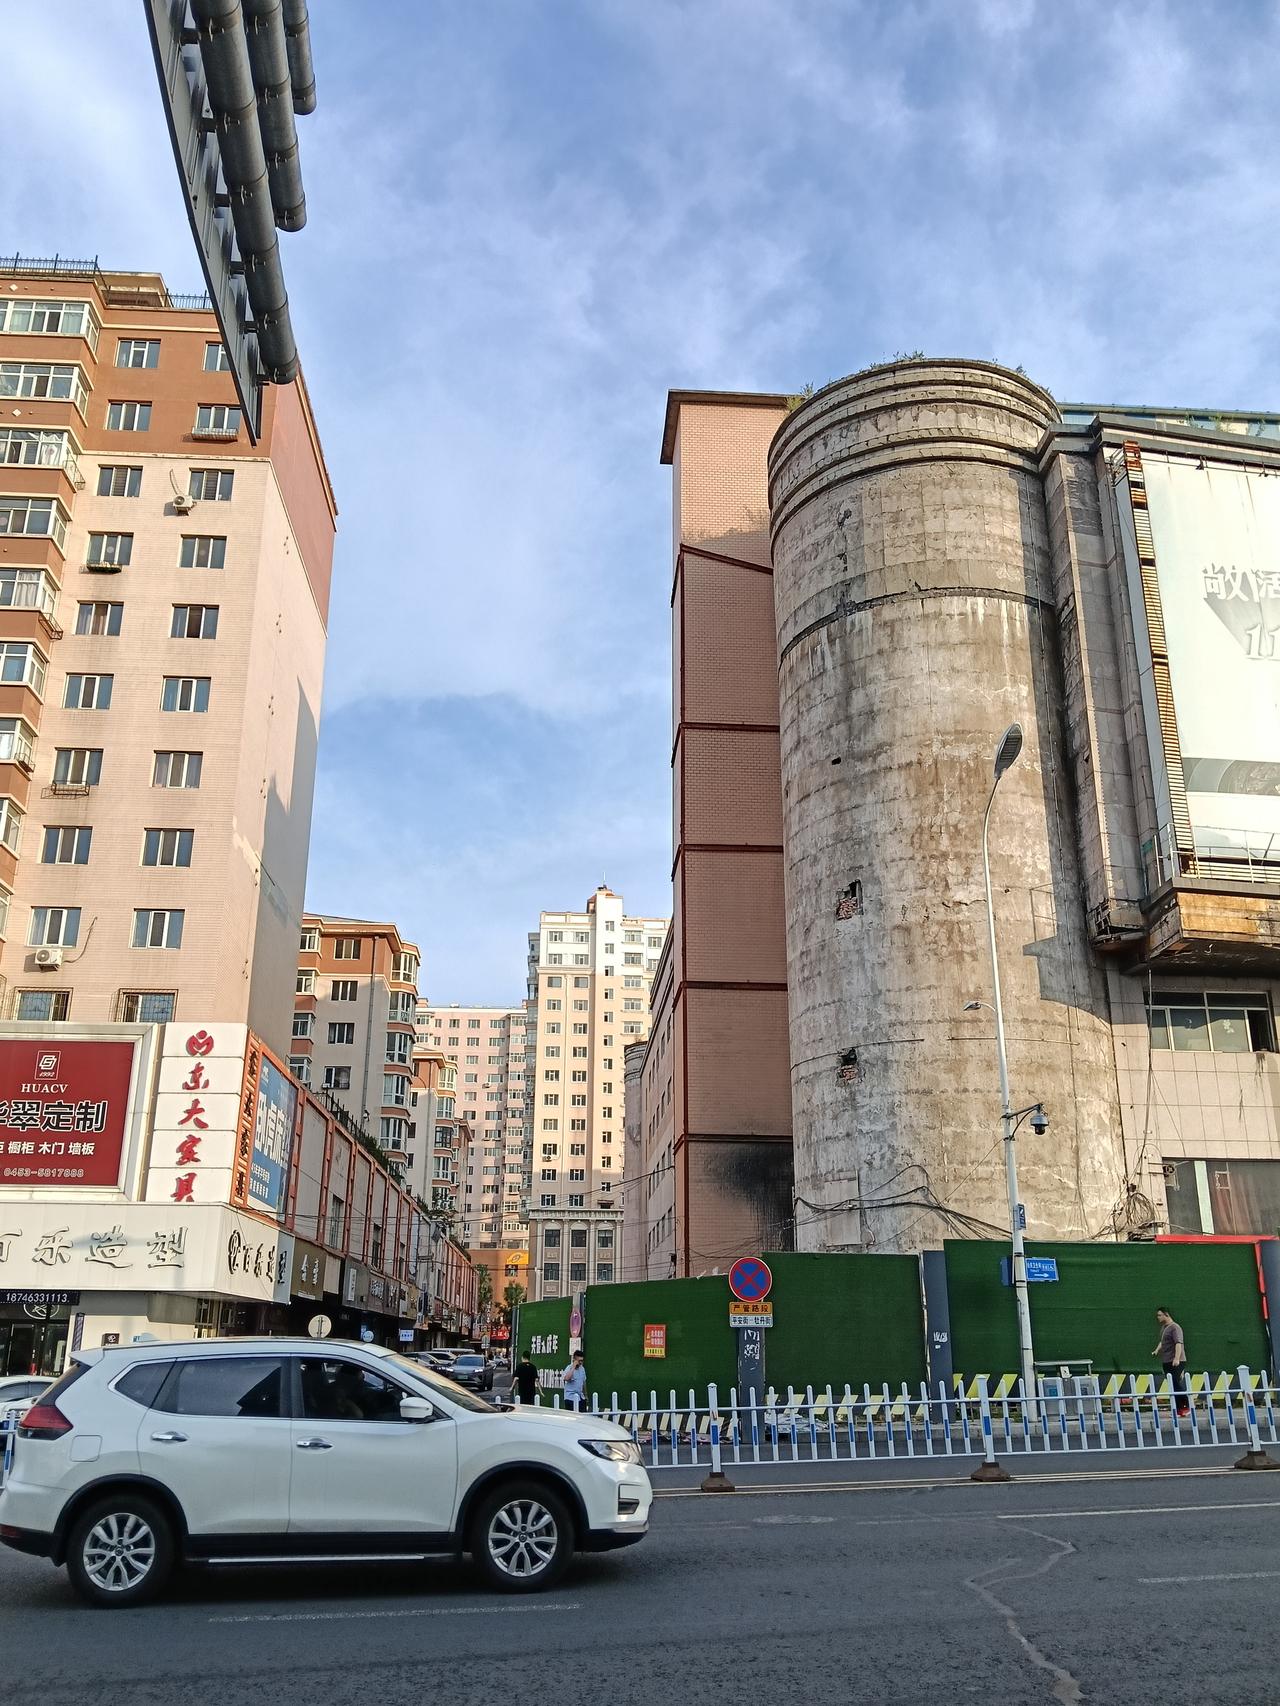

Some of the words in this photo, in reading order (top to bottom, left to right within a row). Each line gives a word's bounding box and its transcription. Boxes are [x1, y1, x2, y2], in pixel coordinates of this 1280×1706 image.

[21, 1083, 68, 1094] HUACV
[0, 1099, 109, 1133] 翠定制
[8, 1141, 35, 1155] 橱柜
[38, 1141, 65, 1155] 木门
[68, 1142, 95, 1156] 墙板
[733, 1304, 769, 1313] 严管路段
